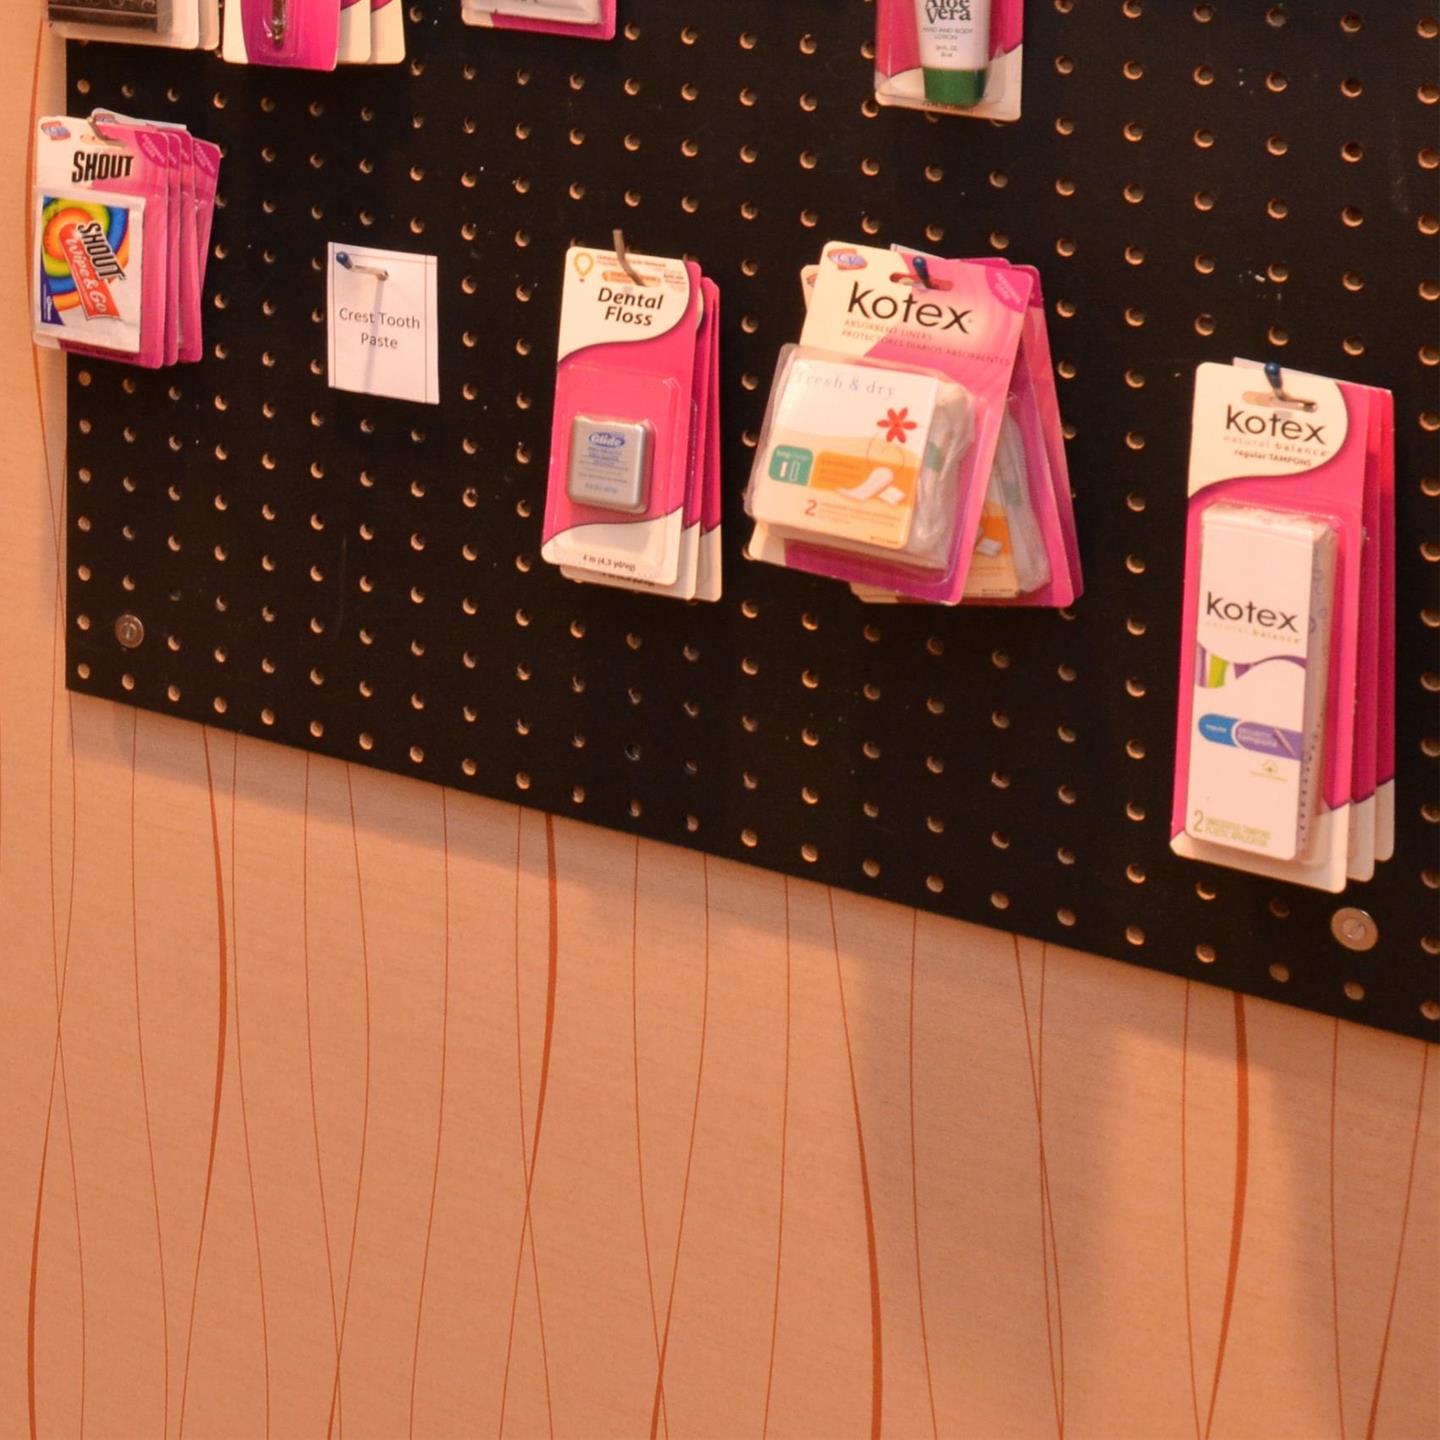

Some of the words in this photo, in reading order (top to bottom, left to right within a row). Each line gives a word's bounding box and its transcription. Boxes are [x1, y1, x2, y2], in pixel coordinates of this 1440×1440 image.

[925, 7, 972, 25] Vera
[72, 150, 134, 184] SHOUT
[78, 220, 125, 281] SHOUT
[598, 287, 664, 310] Dental
[339, 307, 376, 324] Crest
[378, 311, 420, 330] Tooth
[604, 306, 653, 327] Floss
[361, 332, 398, 349] Paste
[865, 378, 895, 401] dry
[1234, 448, 1267, 461] regular
[1269, 453, 1312, 468] TAMPONS
[804, 500, 817, 517] 2
[1193, 810, 1204, 832] 2
